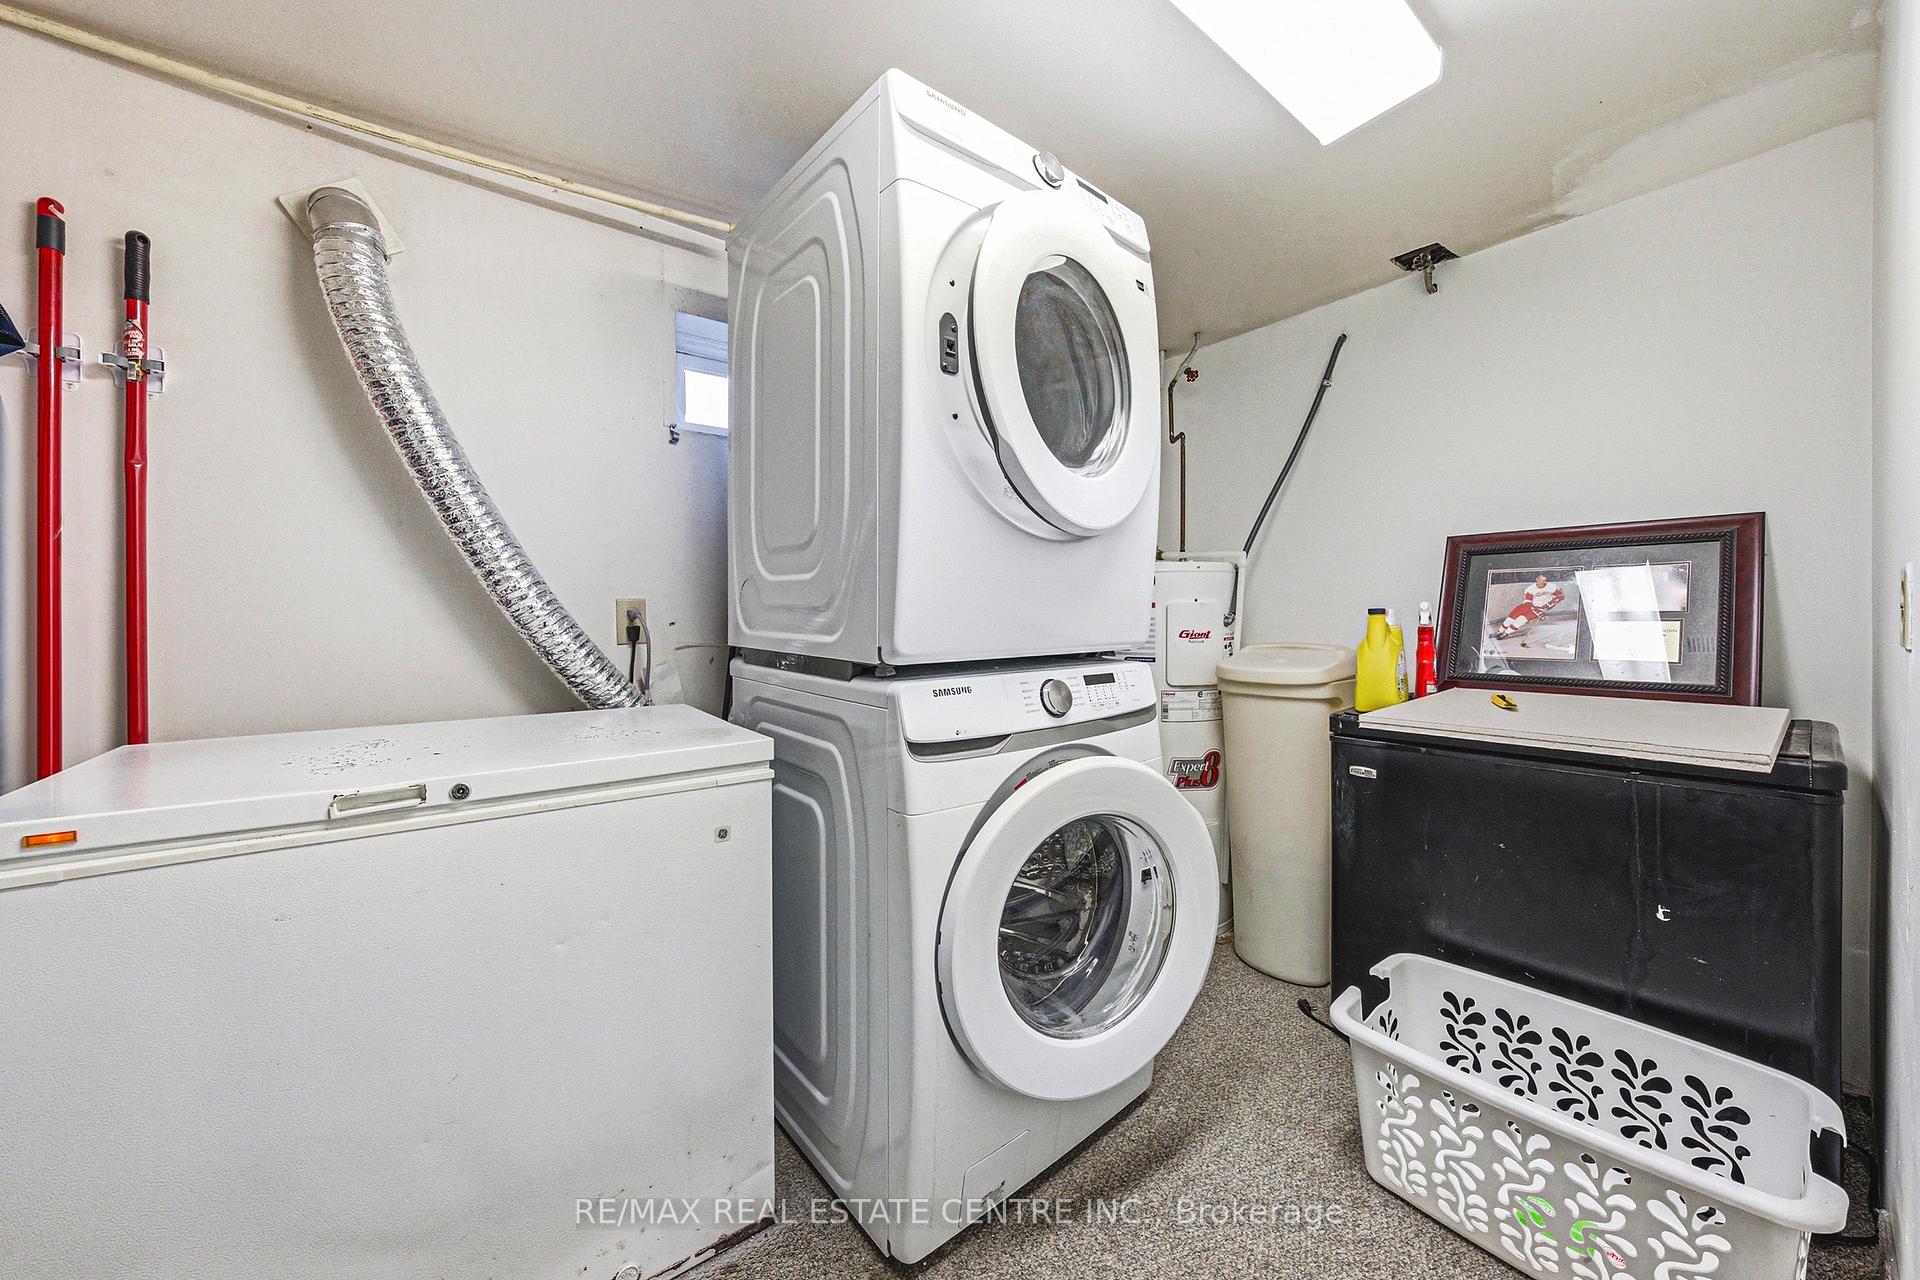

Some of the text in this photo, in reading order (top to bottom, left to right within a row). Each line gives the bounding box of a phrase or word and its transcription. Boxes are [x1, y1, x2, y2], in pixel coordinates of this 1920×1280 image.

[1178, 629, 1211, 640] Giant
[932, 686, 972, 698] SAMSUNG
[1173, 751, 1221, 787] Expert 8
[1176, 776, 1201, 788] Plus
